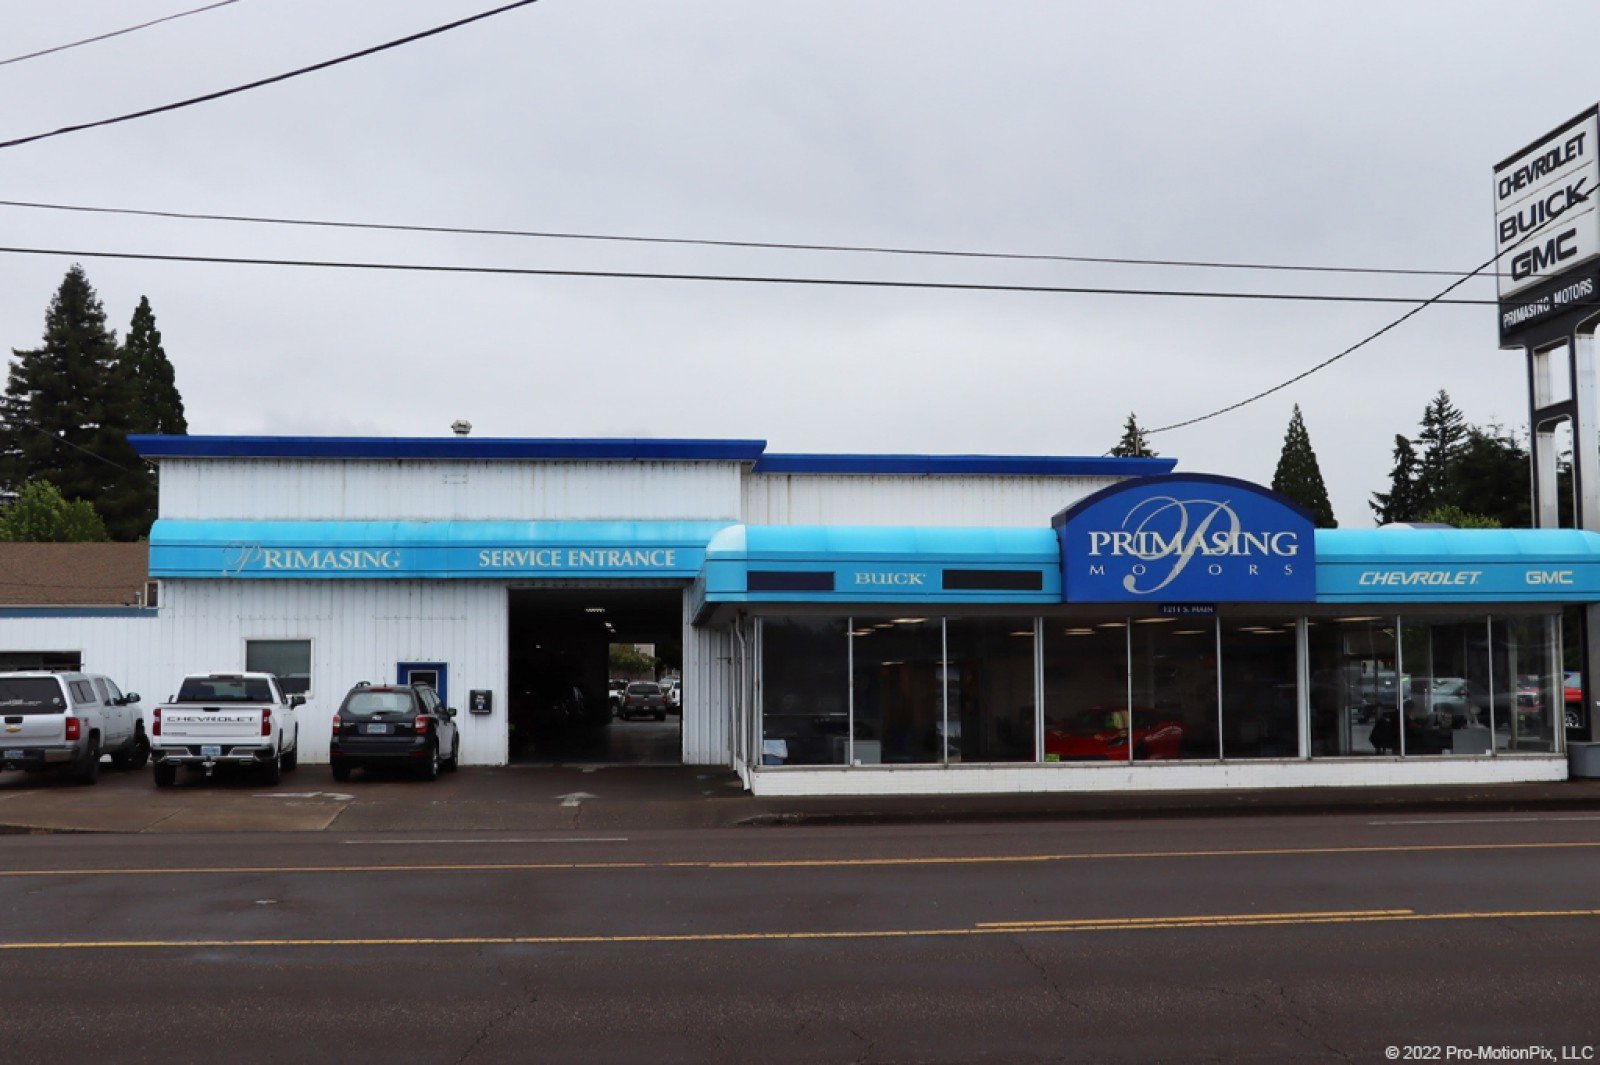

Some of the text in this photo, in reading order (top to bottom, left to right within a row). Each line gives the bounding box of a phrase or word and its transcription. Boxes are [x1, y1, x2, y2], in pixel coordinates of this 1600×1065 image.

[1499, 131, 1586, 201] CHEVROLET
[1499, 176, 1589, 244] BUICK
[1510, 227, 1578, 282] GMC
[1503, 278, 1593, 329] PRIMASING MOTORS
[1088, 531, 1299, 557] PRIMASING
[221, 541, 401, 577] PRIMASING
[478, 549, 676, 567] SERVICE ENTRANCE
[1089, 563, 1294, 576] MOORS
[854, 572, 922, 585] BUICK
[1358, 571, 1483, 585] CHEVROLET
[1525, 570, 1574, 585] GMC
